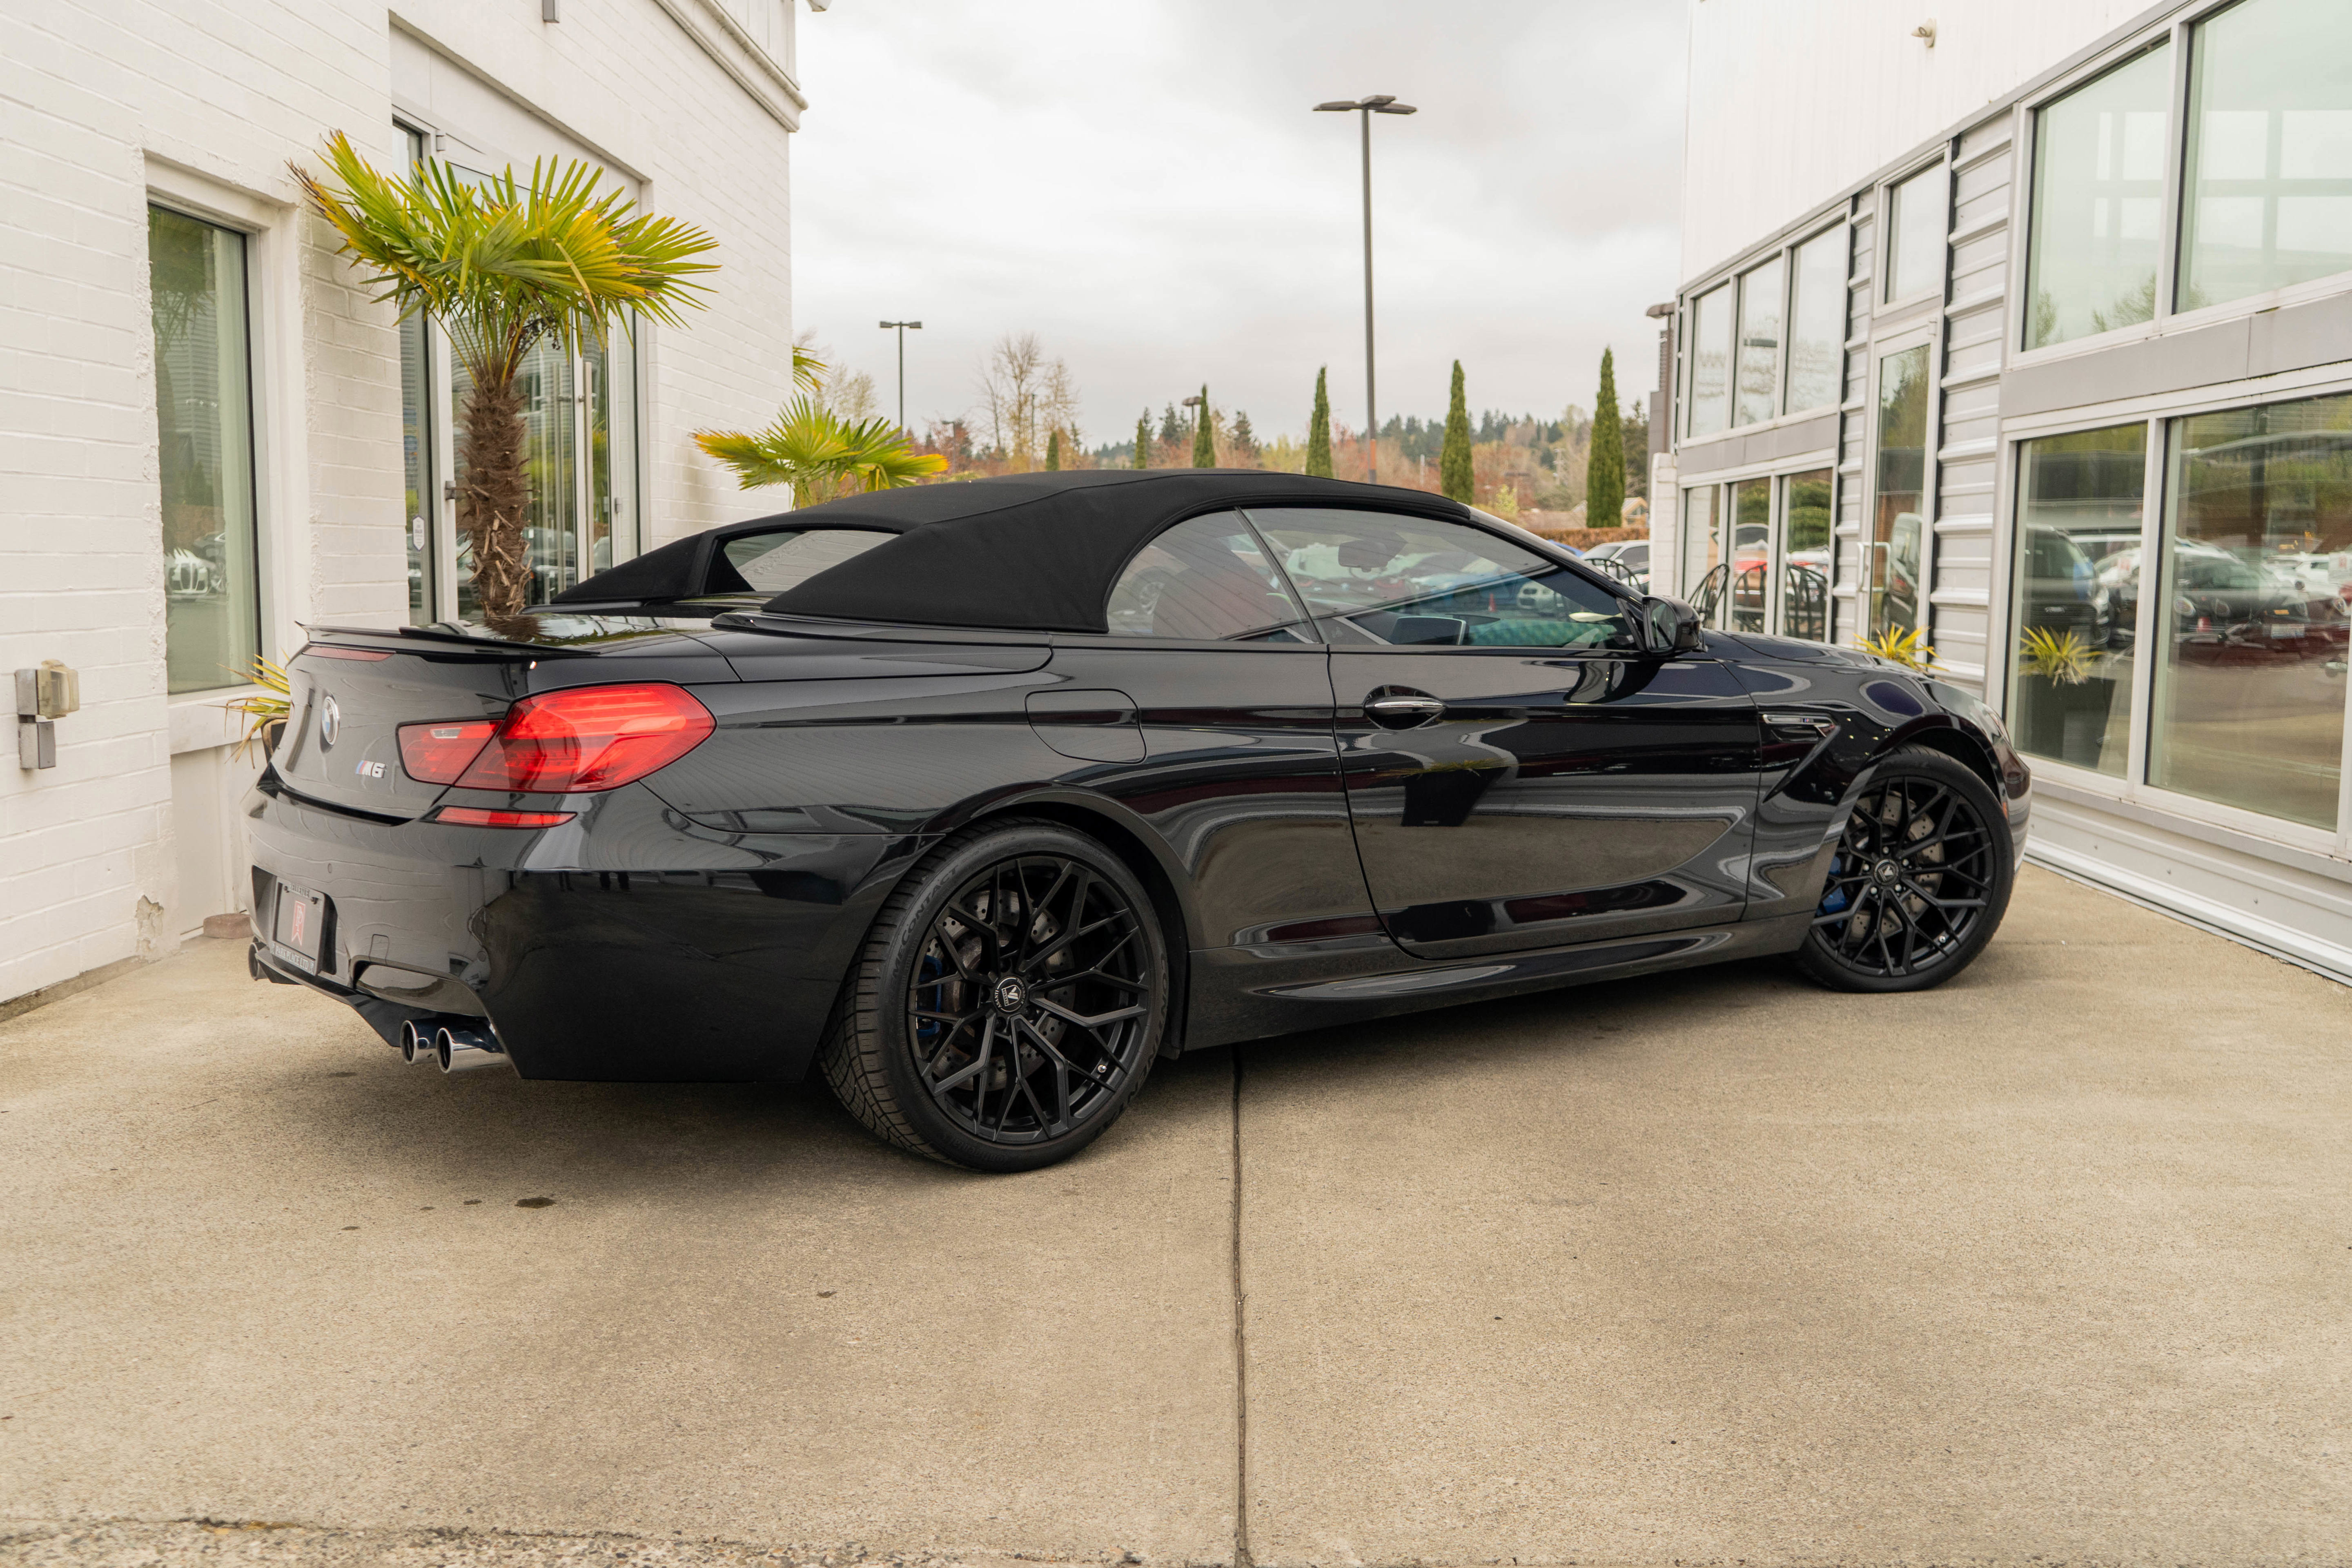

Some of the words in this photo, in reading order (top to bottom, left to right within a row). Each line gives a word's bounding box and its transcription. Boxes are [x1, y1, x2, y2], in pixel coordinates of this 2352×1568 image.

[355, 760, 385, 777] M6
[275, 945, 286, 959] PARK
[286, 950, 300, 966] PLACE
[299, 957, 309, 970] LTD
